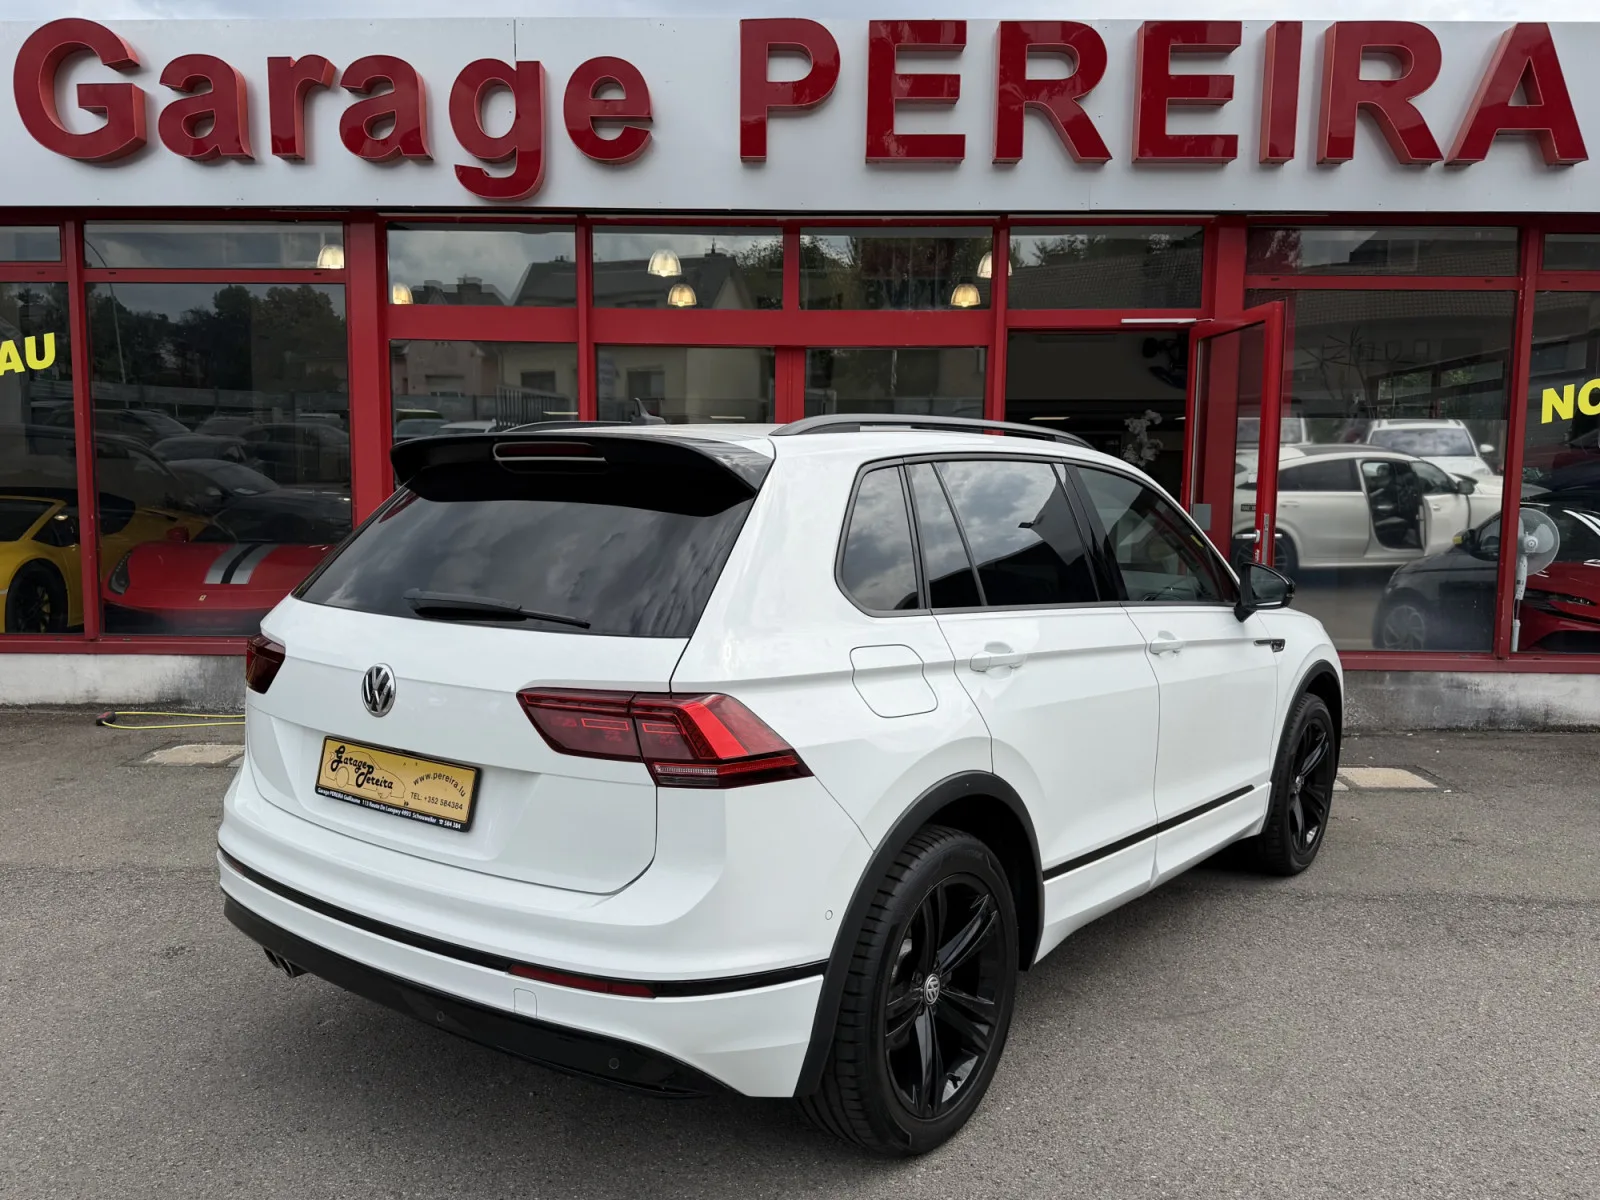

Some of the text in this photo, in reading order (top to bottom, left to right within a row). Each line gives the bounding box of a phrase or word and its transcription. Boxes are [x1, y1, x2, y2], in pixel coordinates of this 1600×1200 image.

[13, 18, 1588, 201] Garage PEREIRA
[330, 745, 367, 774] Garage
[355, 764, 394, 788] Pereira
[413, 772, 466, 797] www.pereira.lu
[411, 792, 463, 810] TEL: +352 584384
